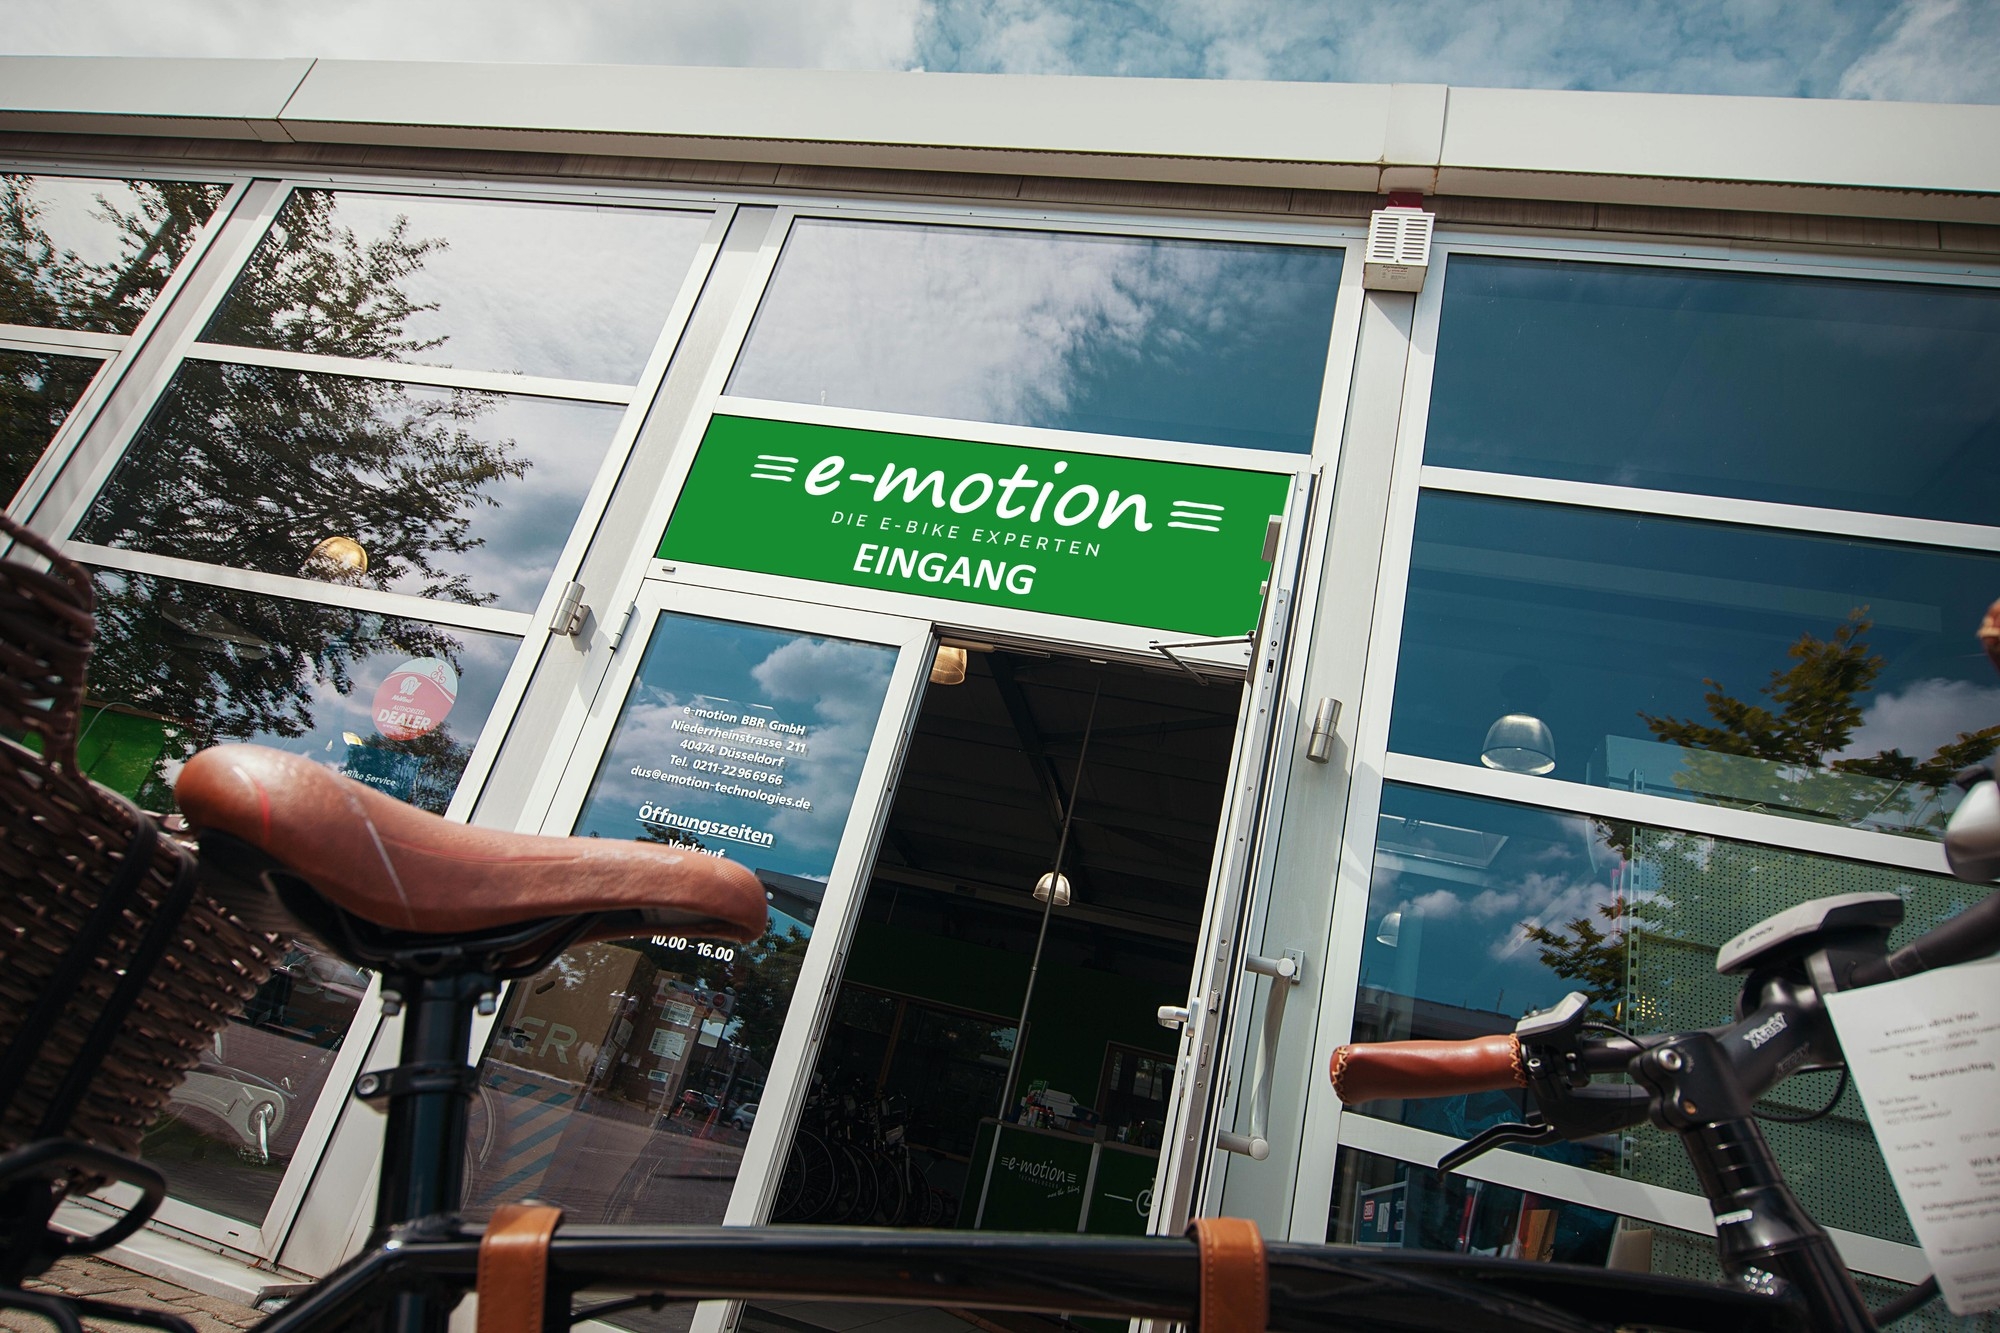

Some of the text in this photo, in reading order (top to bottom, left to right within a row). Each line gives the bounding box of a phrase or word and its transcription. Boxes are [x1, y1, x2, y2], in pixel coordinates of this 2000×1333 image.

[804, 456, 1153, 532] e-motion
[831, 511, 1101, 558] DIE E-BIKE EXPERTEN
[852, 543, 1037, 595] EINGANG
[376, 708, 432, 731] DEALER
[683, 705, 806, 735] e-motion BBR GmbH
[671, 719, 806, 753] Niederrheinstrasse 211
[670, 754, 688, 767] Tel.
[680, 739, 785, 767] 40474 Düsseldorf
[365, 773, 396, 787] Service
[630, 765, 811, 811] dus@emotion-technologies.de
[637, 801, 774, 846] Öffnungszeiten
[651, 935, 688, 951] 10.00
[697, 942, 735, 963] 16.00
[1008, 1156, 1065, 1183] e-motion
